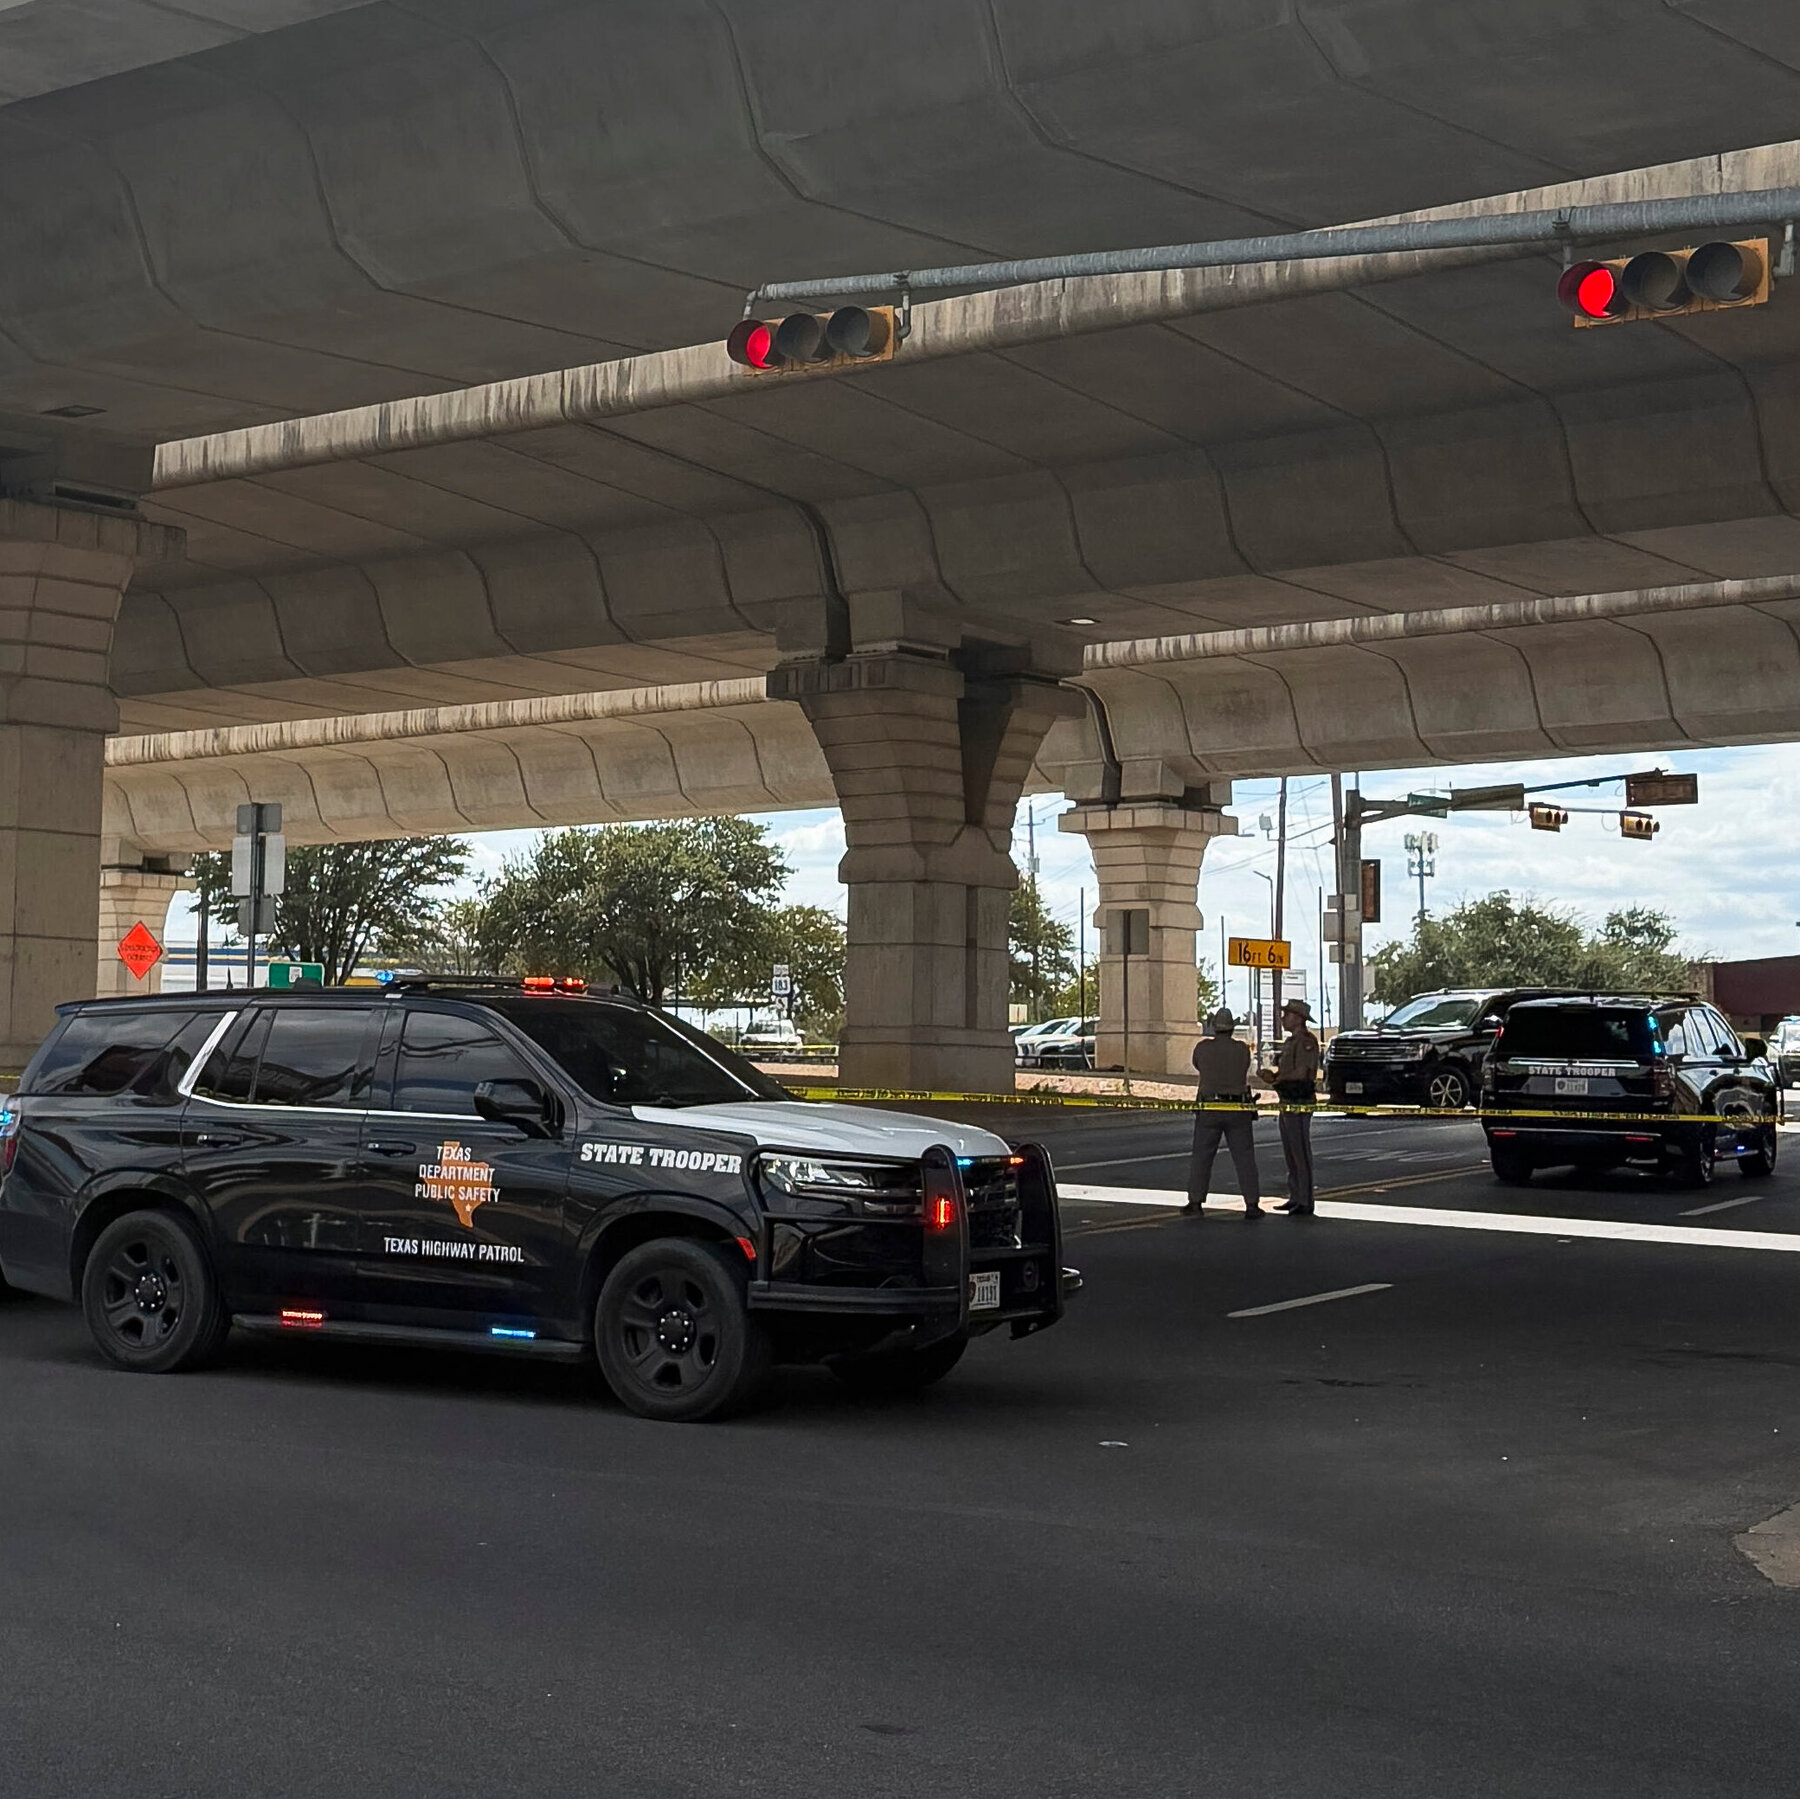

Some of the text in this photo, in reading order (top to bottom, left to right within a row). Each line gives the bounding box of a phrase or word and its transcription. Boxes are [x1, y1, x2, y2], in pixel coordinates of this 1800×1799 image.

[1528, 1066, 1616, 1076] STATE TROOPER
[436, 1145, 472, 1162] TEXAS
[580, 1142, 742, 1174] STATE TROOPER
[419, 1164, 496, 1182] DEPARTMENT
[414, 1183, 501, 1203] PUBLIC SAFETY
[384, 1237, 524, 1262] TEXAS HIGHWAY PATROL
